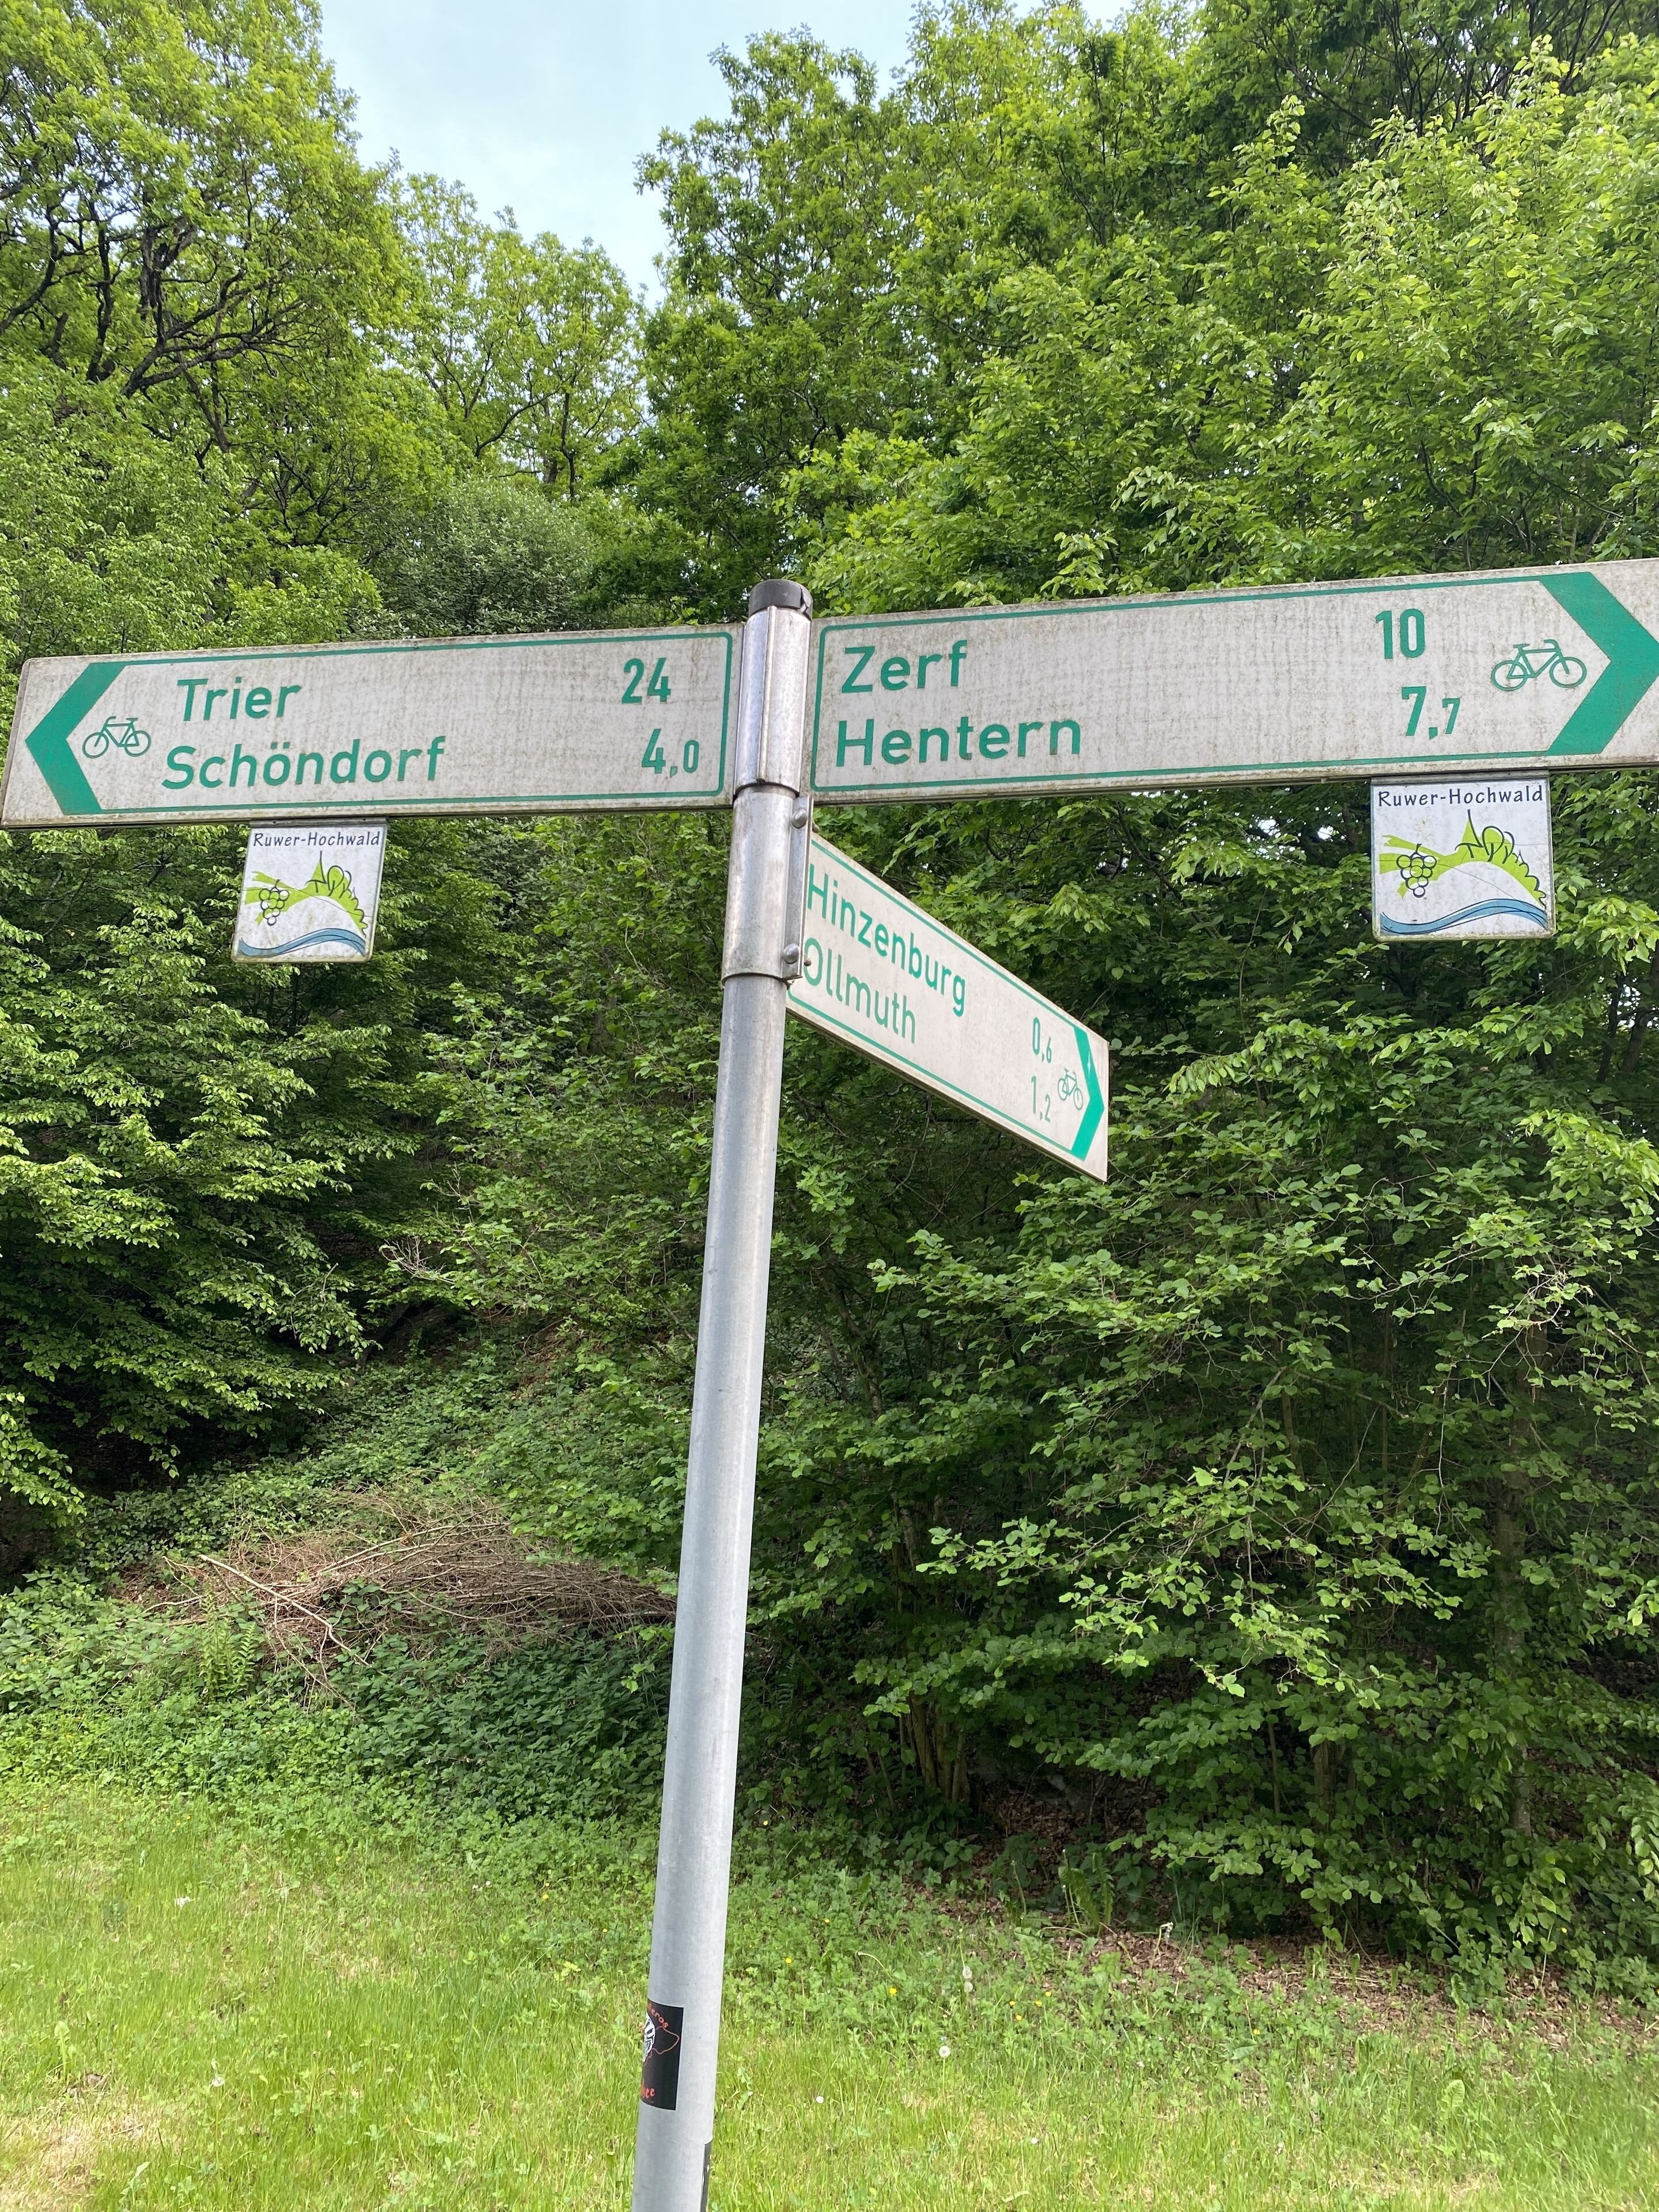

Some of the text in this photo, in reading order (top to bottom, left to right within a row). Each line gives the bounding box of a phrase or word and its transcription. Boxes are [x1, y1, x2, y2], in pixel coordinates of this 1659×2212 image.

[842, 608, 1425, 694] Zerf 10
[177, 658, 672, 721] Trier 24
[162, 729, 700, 789] Schöndorf 4,0
[836, 685, 1461, 767] Hentern 7,7
[1378, 785, 1543, 807] Ruwer-Hochwald
[253, 831, 381, 847] Ruwer-Hochwald
[807, 863, 1052, 1064] Hinzenburg 0,6
[803, 937, 1051, 1123] Ollmuth 1,2
